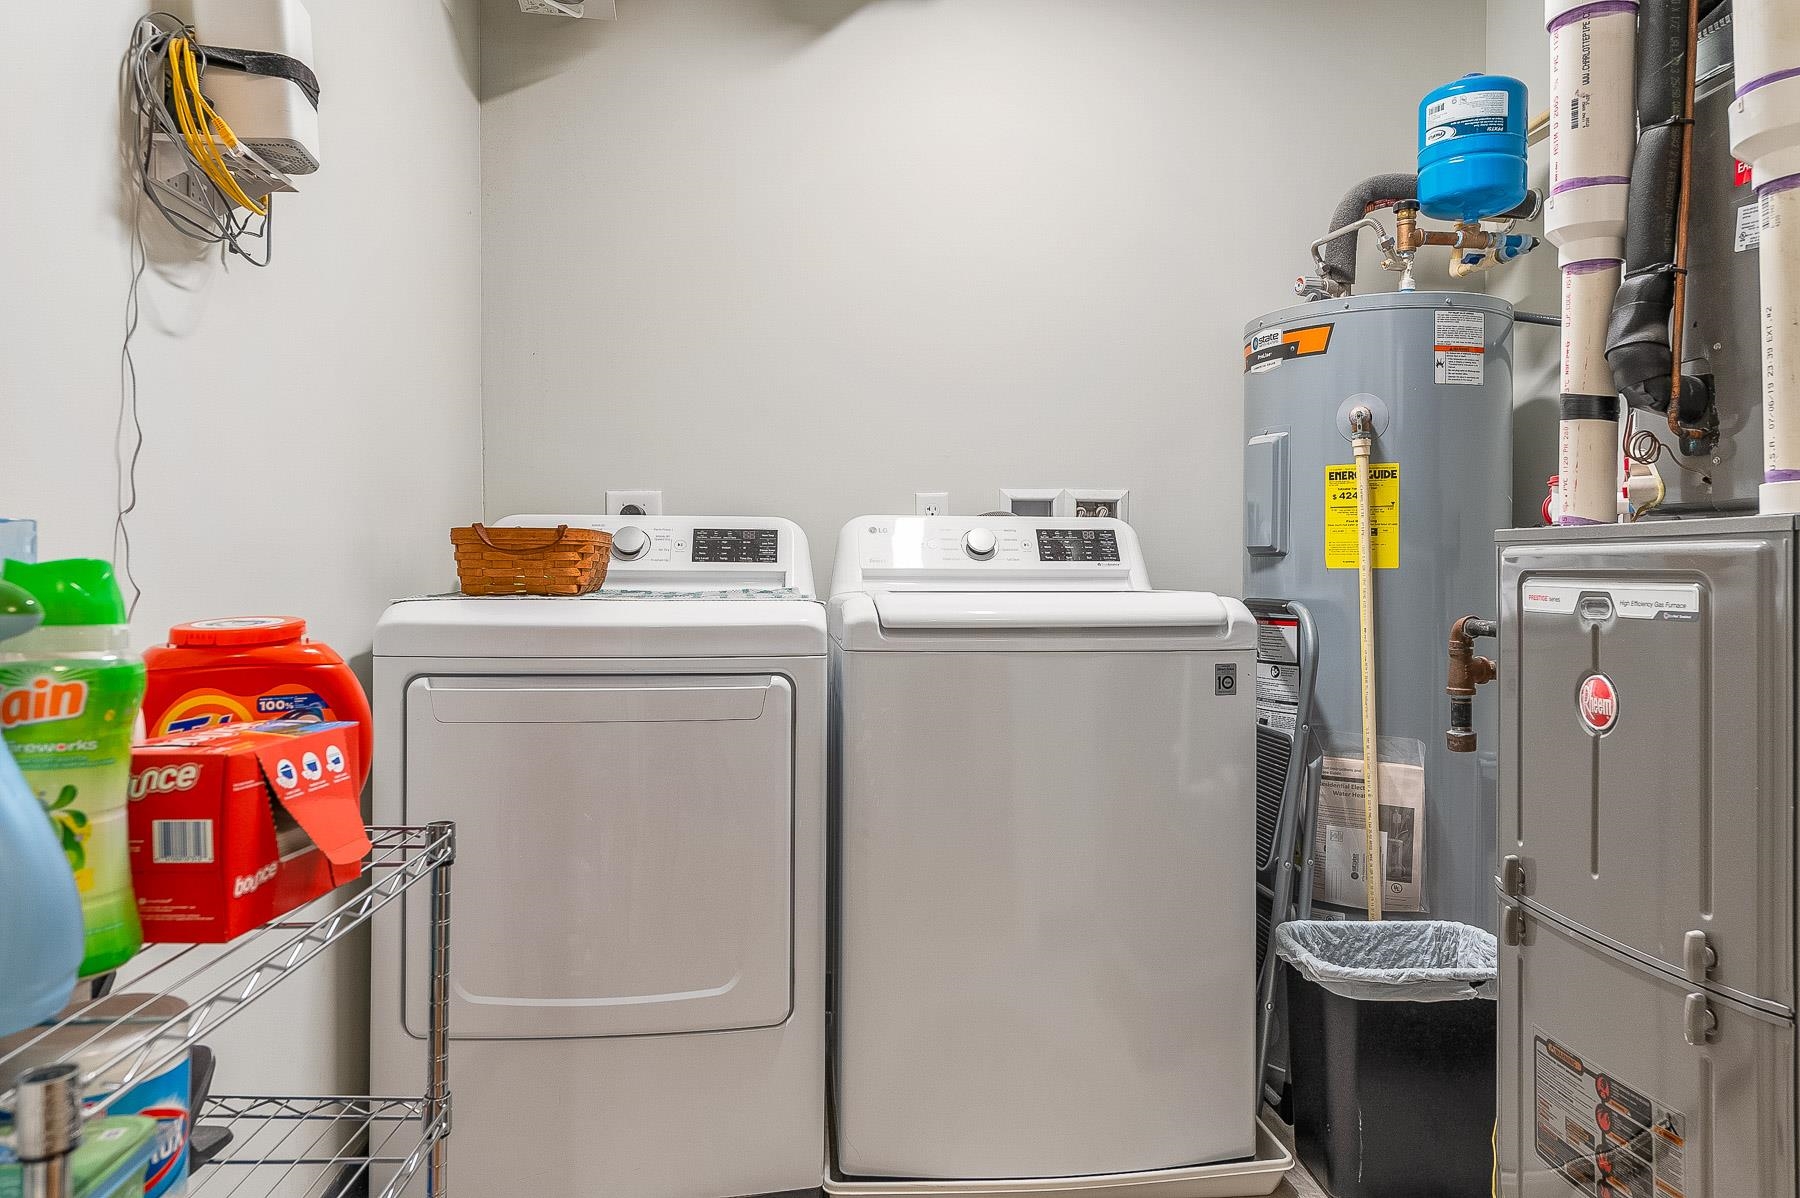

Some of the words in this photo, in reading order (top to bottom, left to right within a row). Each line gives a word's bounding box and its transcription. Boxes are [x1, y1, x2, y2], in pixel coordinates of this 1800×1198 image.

[1737, 162, 1753, 174] EA
[1258, 332, 1279, 345] state
[1328, 471, 1357, 481] ENER
[1339, 491, 1358, 500] 424
[1528, 594, 1549, 602] PRESTIGE
[1619, 600, 1631, 608] High
[1631, 600, 1653, 609] Efficiency
[1654, 601, 1665, 609] Gas
[1, 677, 84, 725] ain
[259, 700, 294, 711] 100%
[128, 764, 199, 799] unce
[233, 862, 278, 898] bounce
